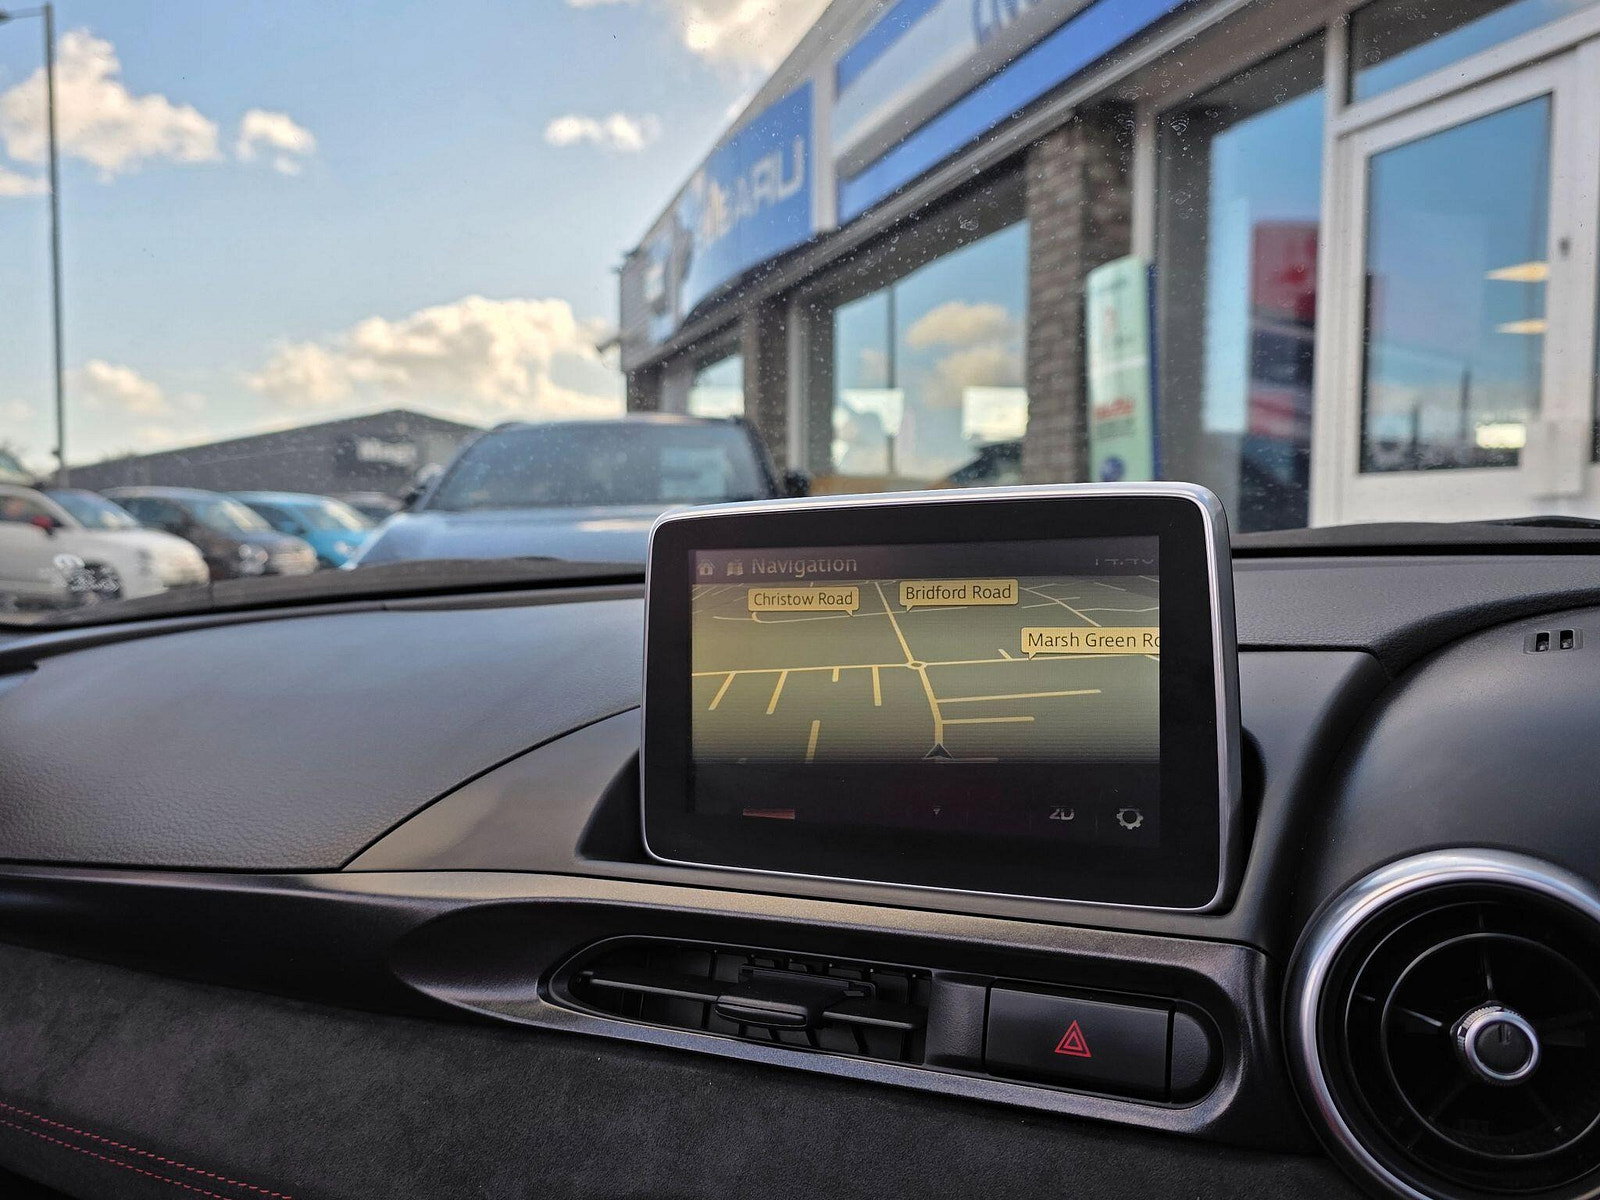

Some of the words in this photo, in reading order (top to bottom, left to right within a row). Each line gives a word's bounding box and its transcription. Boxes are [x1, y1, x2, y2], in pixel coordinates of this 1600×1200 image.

[752, 557, 857, 577] Navigation
[754, 593, 814, 606] Christow
[818, 592, 853, 605] Road
[906, 585, 967, 600] Bridford
[973, 584, 1011, 599] Road
[1028, 632, 1079, 647] Marsh
[1085, 633, 1136, 647] Green
